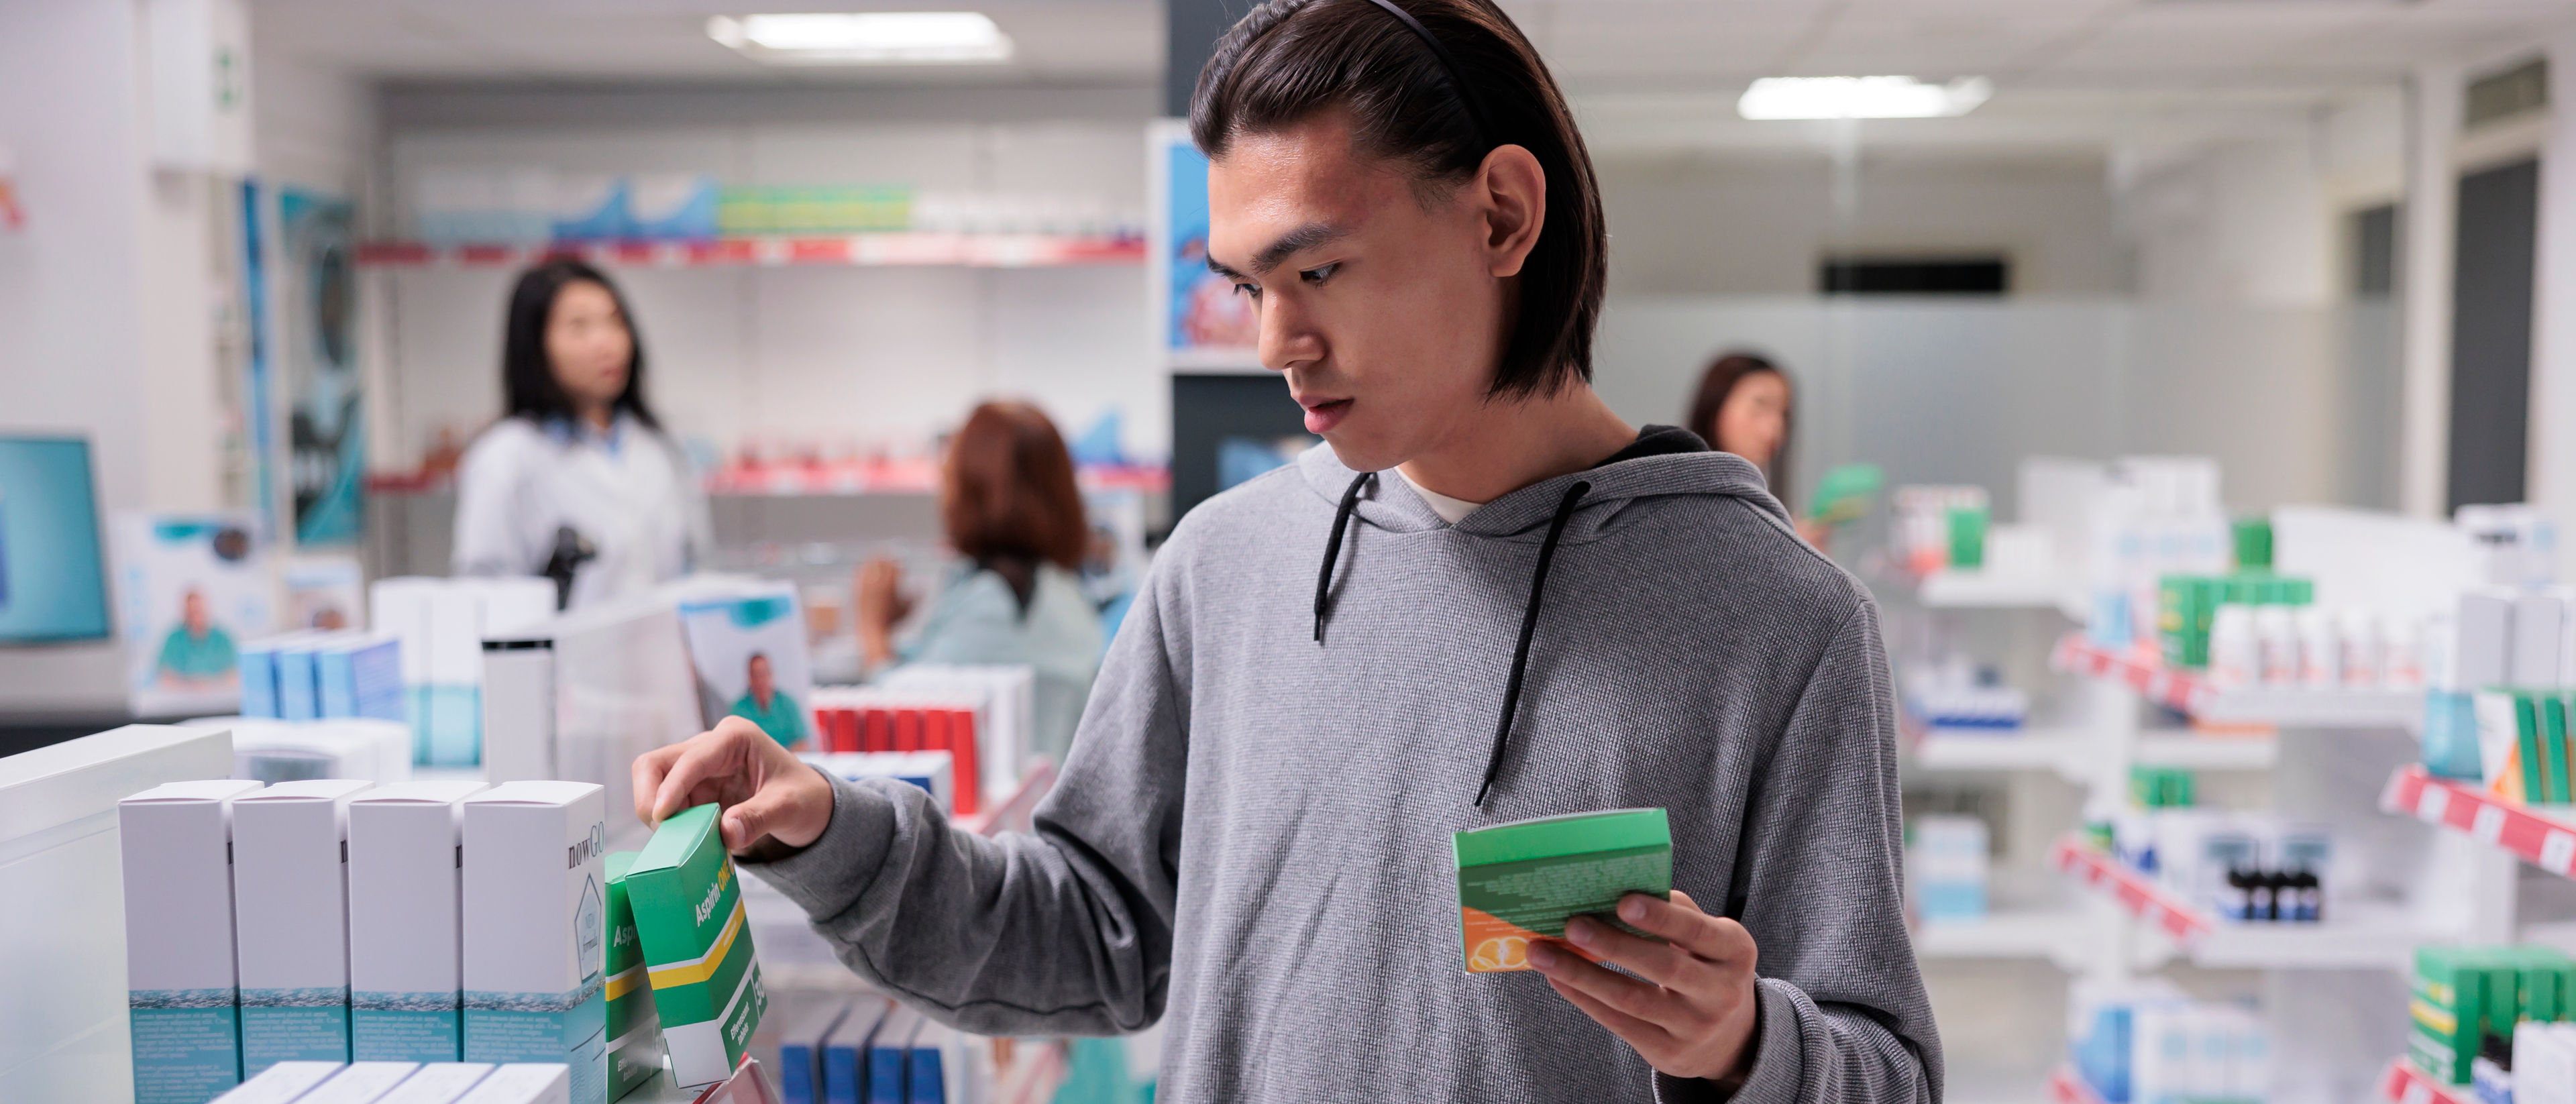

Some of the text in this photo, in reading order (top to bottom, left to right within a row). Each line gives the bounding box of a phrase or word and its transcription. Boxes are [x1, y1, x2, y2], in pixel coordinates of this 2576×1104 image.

[568, 821, 604, 870] nowGO
[696, 859, 731, 928] Aspirin ONE
[613, 923, 639, 948] Aspi
